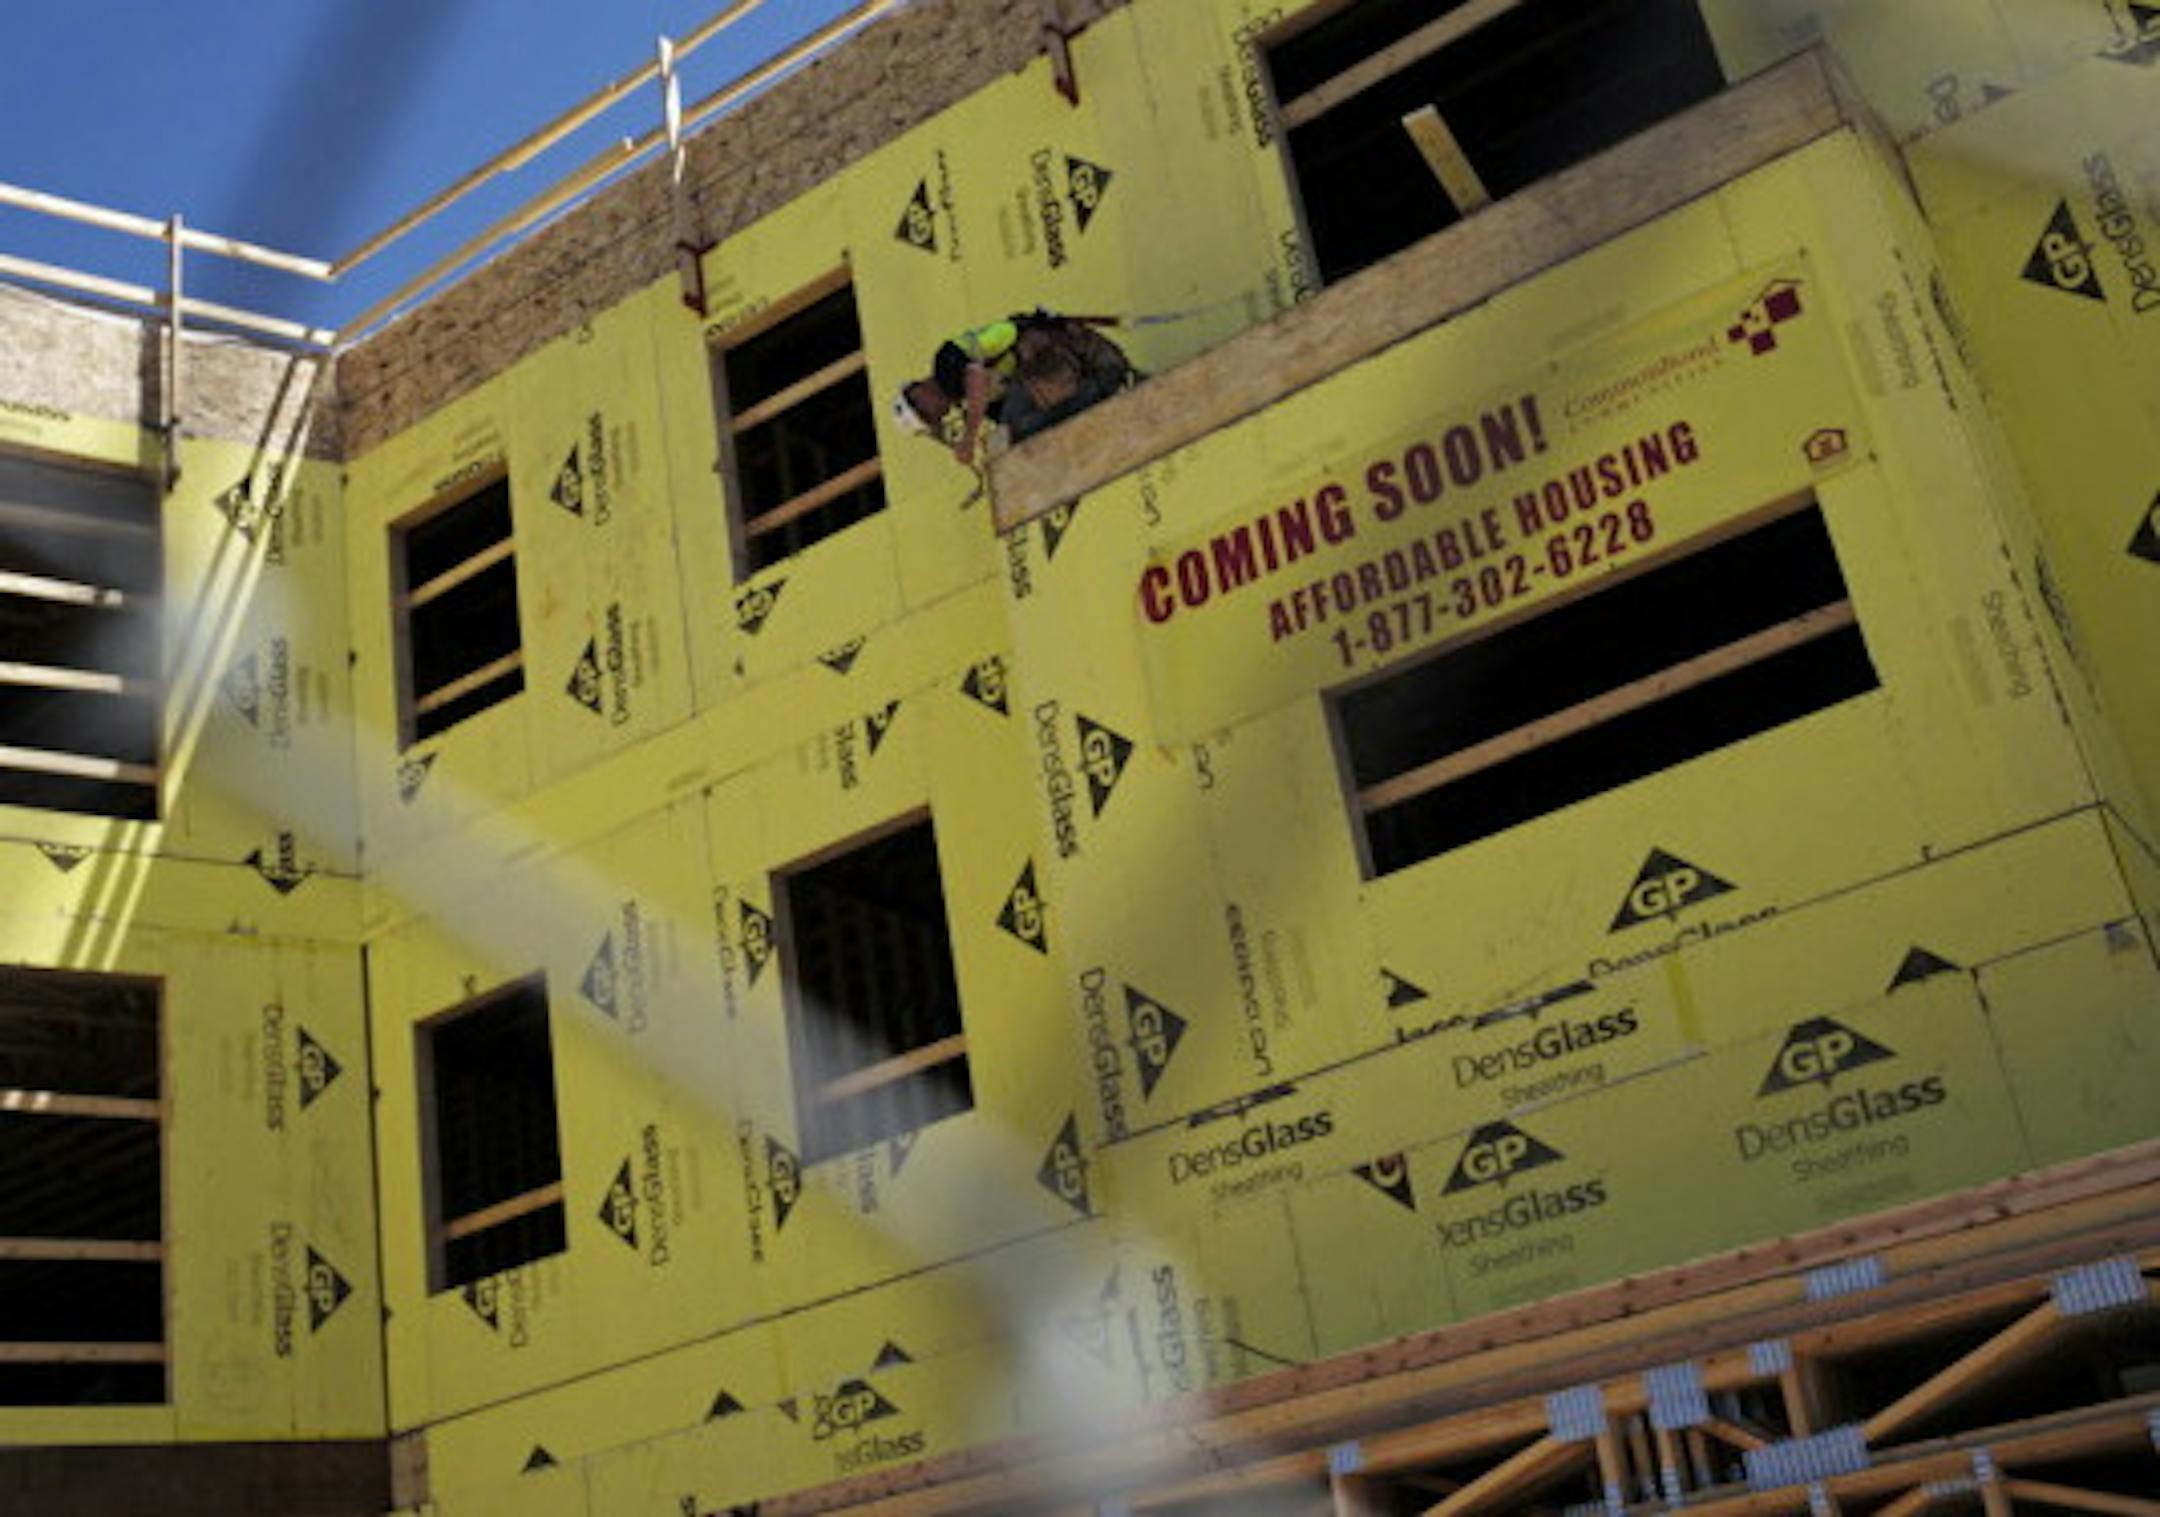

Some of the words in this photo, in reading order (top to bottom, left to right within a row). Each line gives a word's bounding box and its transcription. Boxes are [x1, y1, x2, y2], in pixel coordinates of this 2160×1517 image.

[1139, 483, 1357, 624] COMING
[1366, 393, 1548, 524] SOON!
[1268, 507, 1505, 643] AFFORDABLE
[1513, 420, 1699, 541] HOUSING
[1331, 499, 1656, 669] 1-877-302-6228
[1035, 699, 1078, 860] DensGlass
[1630, 867, 1700, 917] GP
[1452, 1007, 1639, 1089] DensGlass
[1781, 1030, 1857, 1082] GP
[1168, 1109, 1334, 1185] DensGlass
[1463, 1135, 1528, 1180] GP
[1734, 1075, 1948, 1163] DensGlass
[642, 1123, 670, 1267] DensGlass
